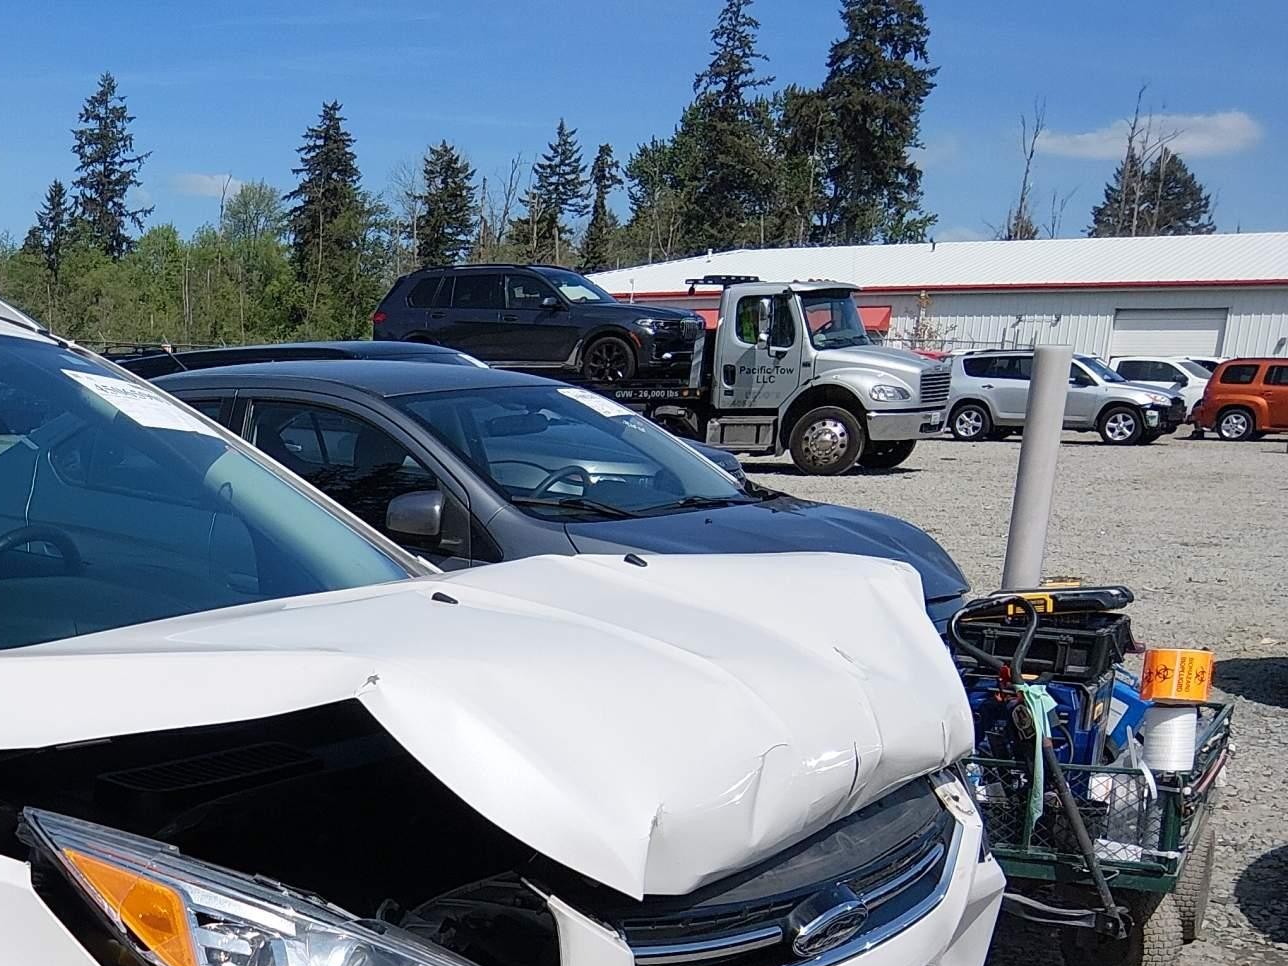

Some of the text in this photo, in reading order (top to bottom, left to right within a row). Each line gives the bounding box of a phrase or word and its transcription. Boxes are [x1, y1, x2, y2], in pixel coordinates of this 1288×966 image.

[739, 365, 794, 375] Pacific Tow
[756, 376, 776, 384] LLC
[615, 390, 633, 398] GVW
[666, 390, 679, 398] lbs
